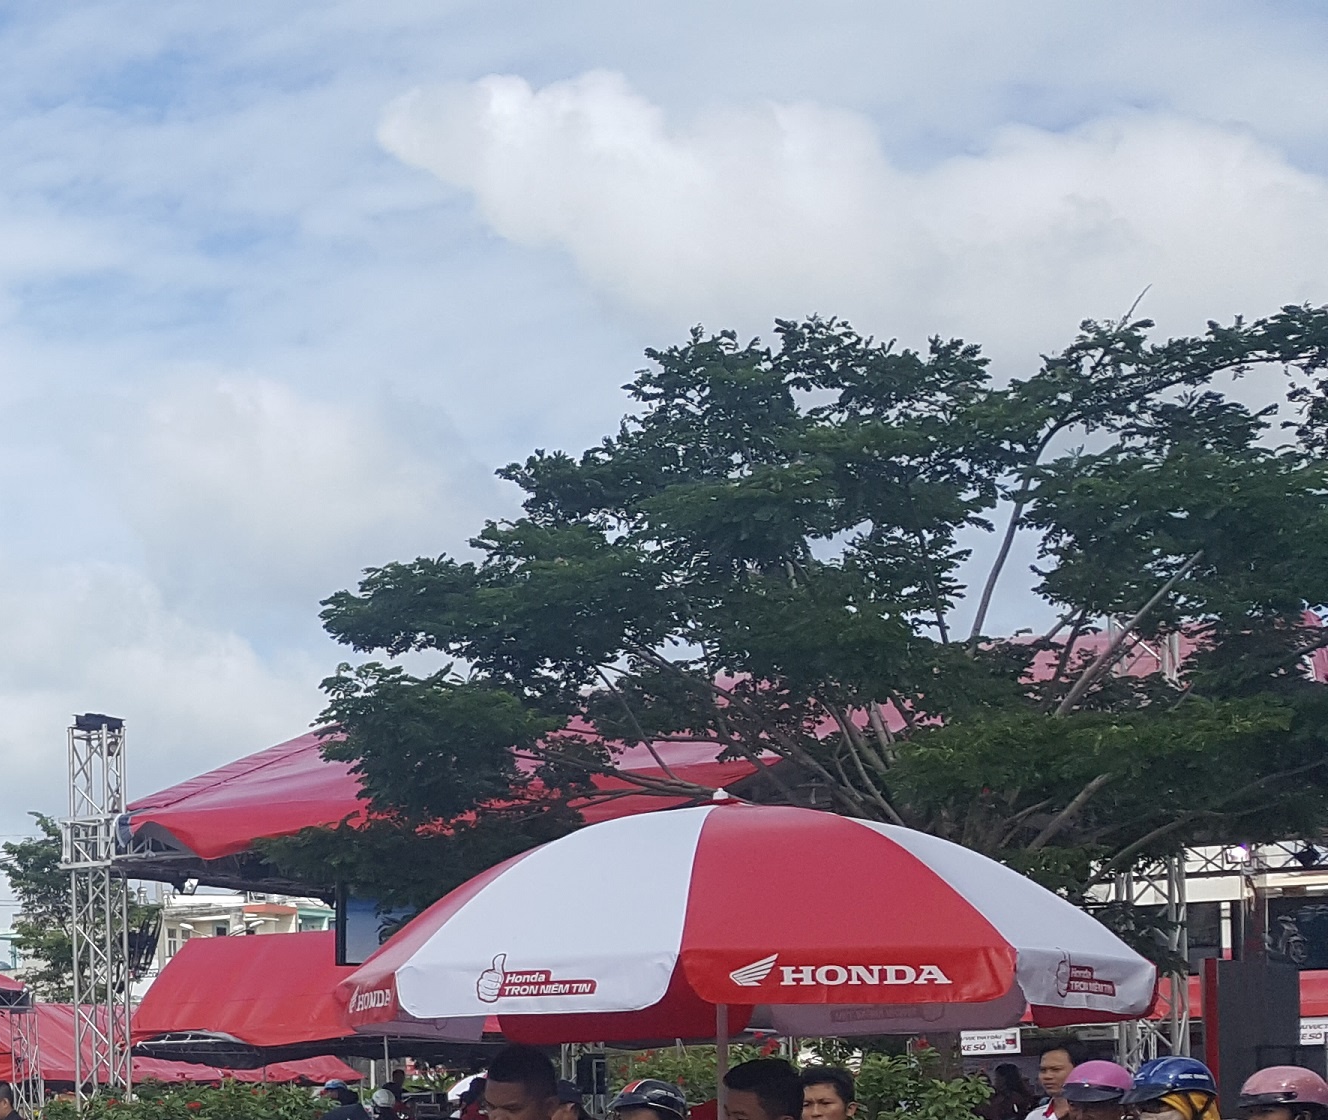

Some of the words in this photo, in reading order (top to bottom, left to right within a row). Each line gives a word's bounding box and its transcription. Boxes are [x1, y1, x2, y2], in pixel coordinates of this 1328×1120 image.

[506, 972, 546, 983] Honda
[779, 965, 952, 986] HONDA
[570, 982, 592, 994] TIN
[356, 988, 392, 1012] HONDA
